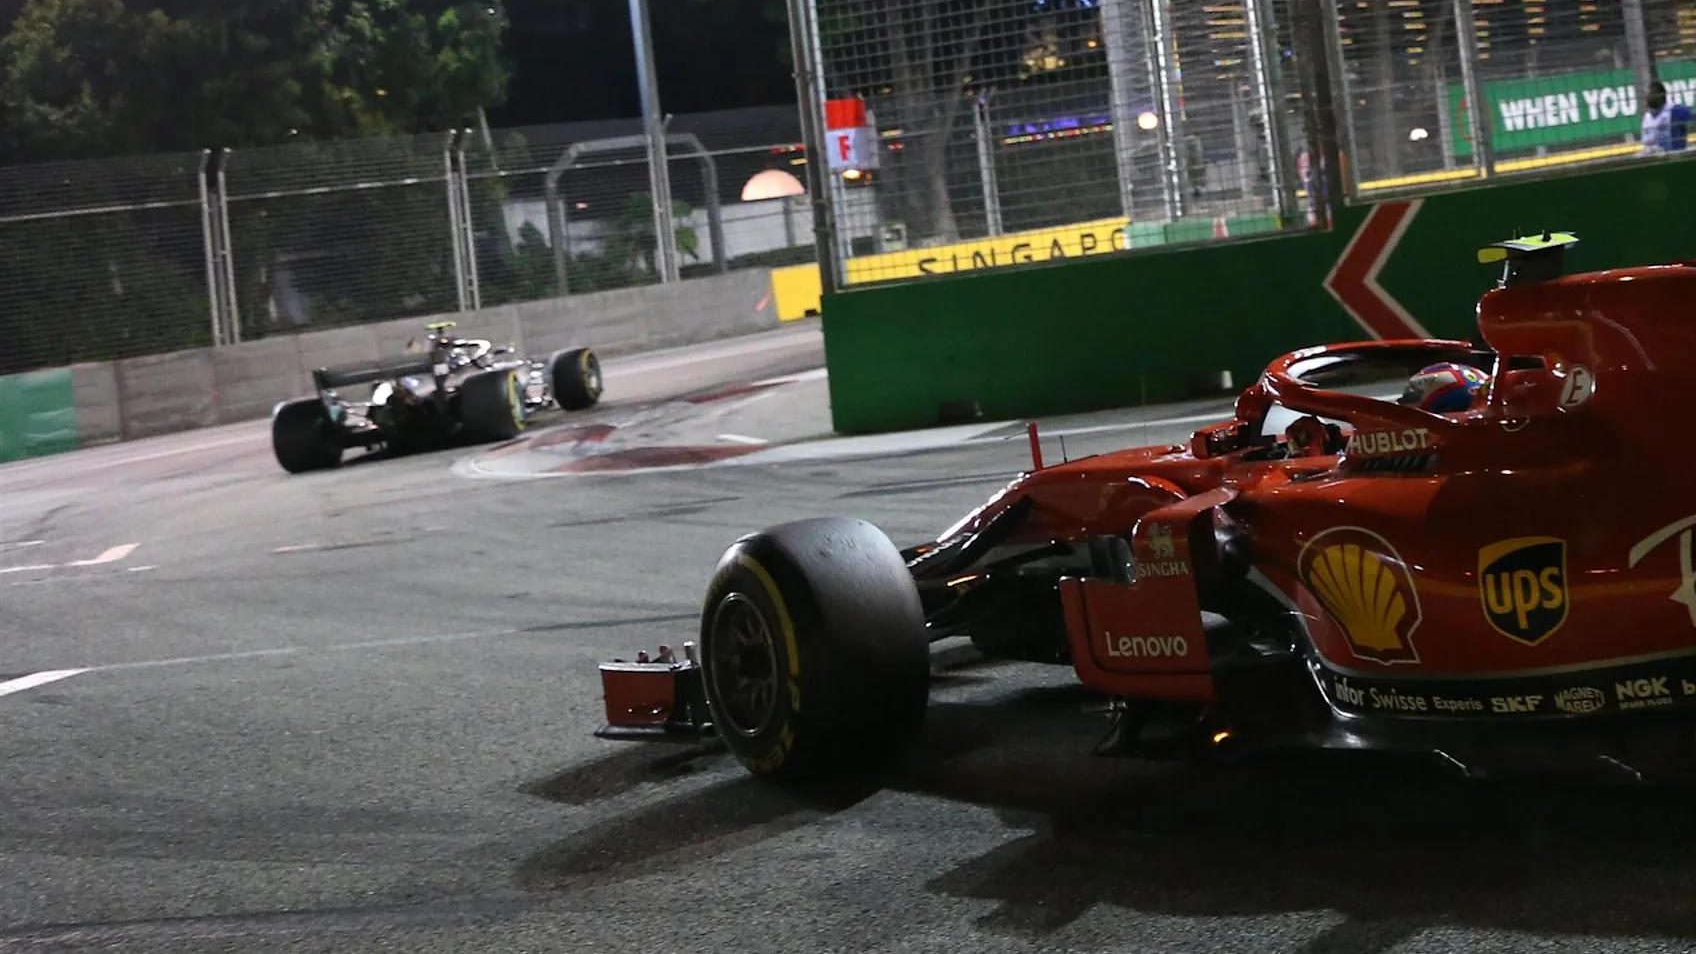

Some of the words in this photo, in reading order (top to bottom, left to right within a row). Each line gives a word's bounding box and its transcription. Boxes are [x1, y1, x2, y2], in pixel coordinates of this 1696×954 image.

[1500, 91, 1580, 132] WHEN
[1582, 84, 1637, 122] YOU
[1349, 428, 1428, 455] HUBLOT
[1139, 561, 1189, 577] SINGHA
[1486, 568, 1563, 629] ups
[1105, 630, 1189, 657] Lenovo
[1371, 687, 1428, 712] Swisse
[1434, 696, 1484, 713] Experis
[1491, 694, 1543, 713] SKF
[1616, 676, 1670, 700] NGK
